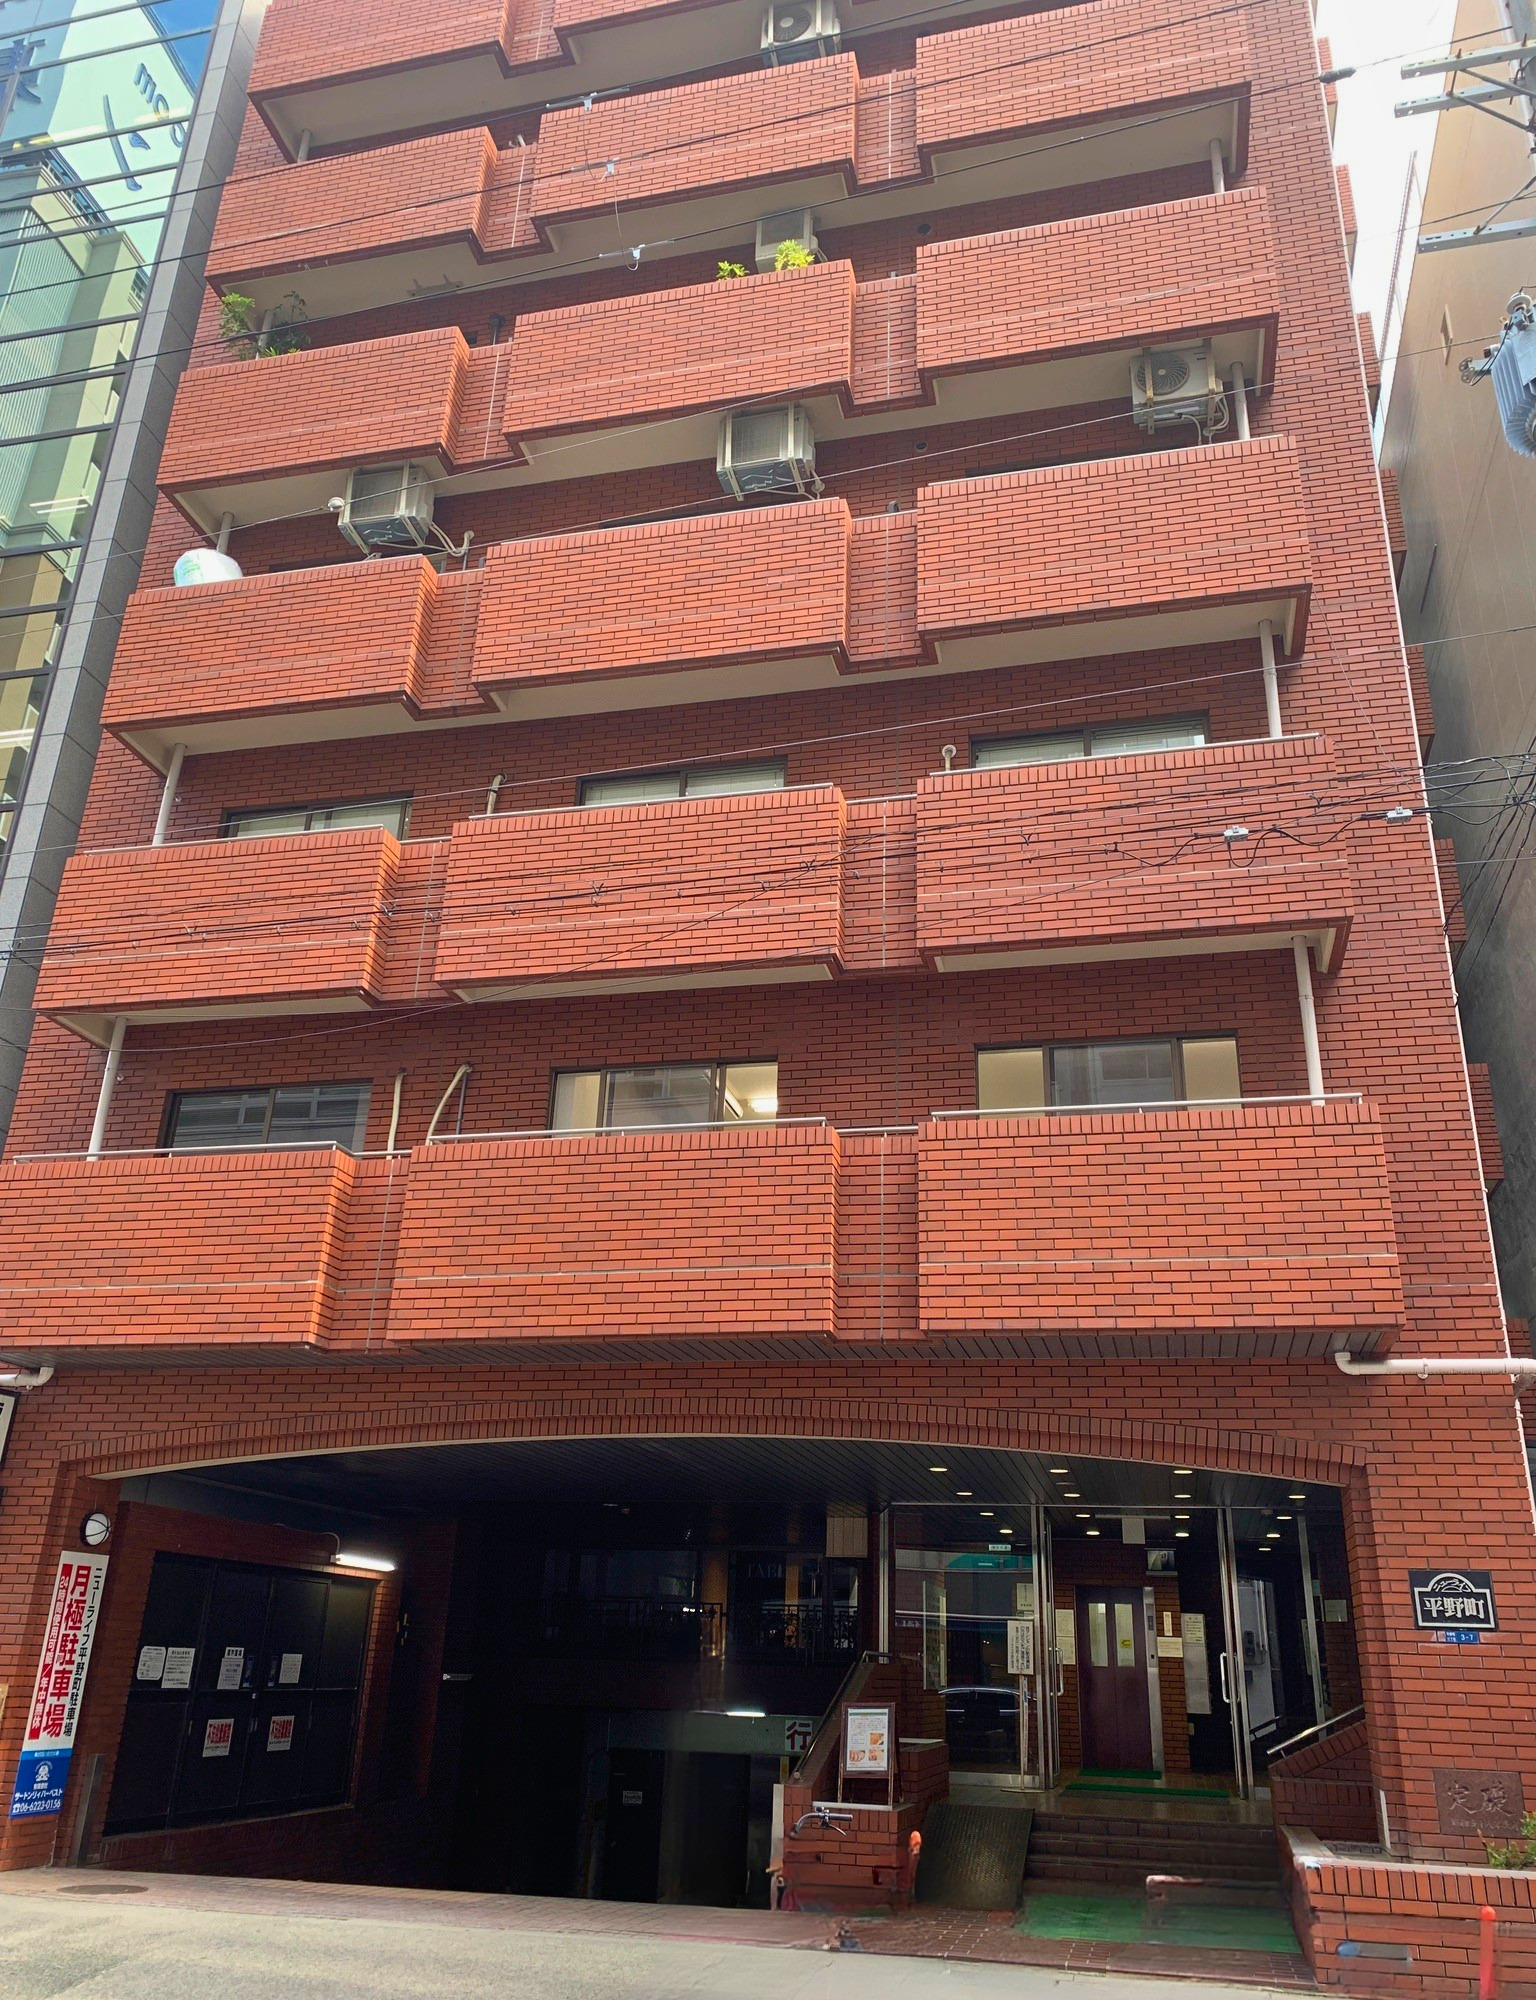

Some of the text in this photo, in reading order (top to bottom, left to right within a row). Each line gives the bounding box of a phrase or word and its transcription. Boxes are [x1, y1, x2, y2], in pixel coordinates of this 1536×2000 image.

[1423, 1597, 1485, 1619] 平野町
[42, 1565, 92, 1738] 月極駐車場
[63, 1568, 103, 1737] ニューライフ平野町駐車場
[786, 1720, 811, 1750] 行
[20, 1799, 61, 1812] 06-6223-0156
